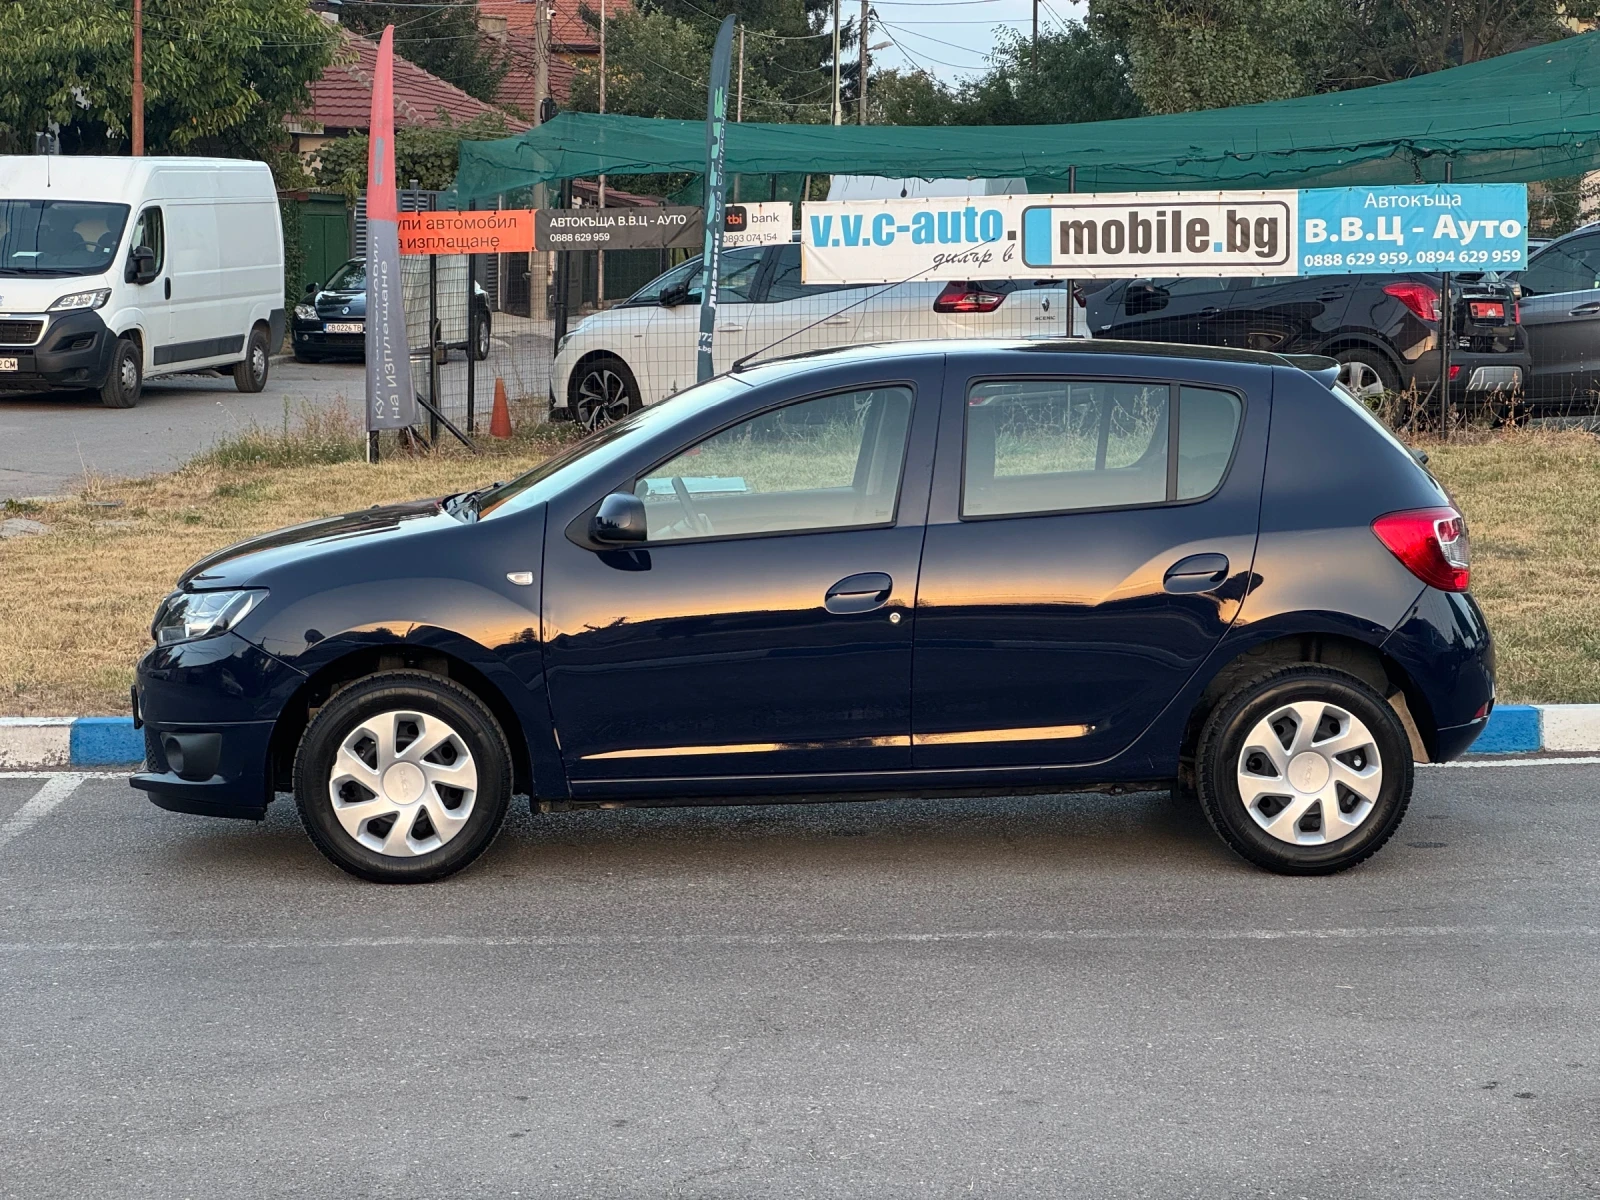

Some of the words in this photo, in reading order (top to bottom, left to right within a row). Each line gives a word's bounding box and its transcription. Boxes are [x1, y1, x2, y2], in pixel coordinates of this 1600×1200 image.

[1364, 192, 1462, 209] Автокъща
[426, 216, 517, 230] автомобил
[550, 216, 616, 228] АВТОКЪЩА
[618, 215, 648, 227] В.В.Ц
[657, 214, 687, 226] АУТО
[726, 213, 742, 225] tbi
[751, 212, 780, 223] bank
[1059, 209, 1278, 258] mobile.bg
[1305, 216, 1404, 246] В.В.Ц
[1432, 214, 1521, 245] Ауто
[407, 236, 500, 250] изплащане
[550, 233, 573, 243] 0888
[575, 233, 592, 242] 629
[593, 232, 610, 242] 959
[722, 234, 744, 243] 0893
[746, 233, 761, 242] 074
[763, 233, 777, 241] 154
[1304, 253, 1343, 267] 0888
[1346, 252, 1376, 266] 629
[1379, 251, 1412, 267] 959,
[1416, 250, 1455, 264] 0894
[1459, 250, 1489, 263] 629
[1492, 249, 1521, 263] 959
[4, 360, 16, 369] CM
